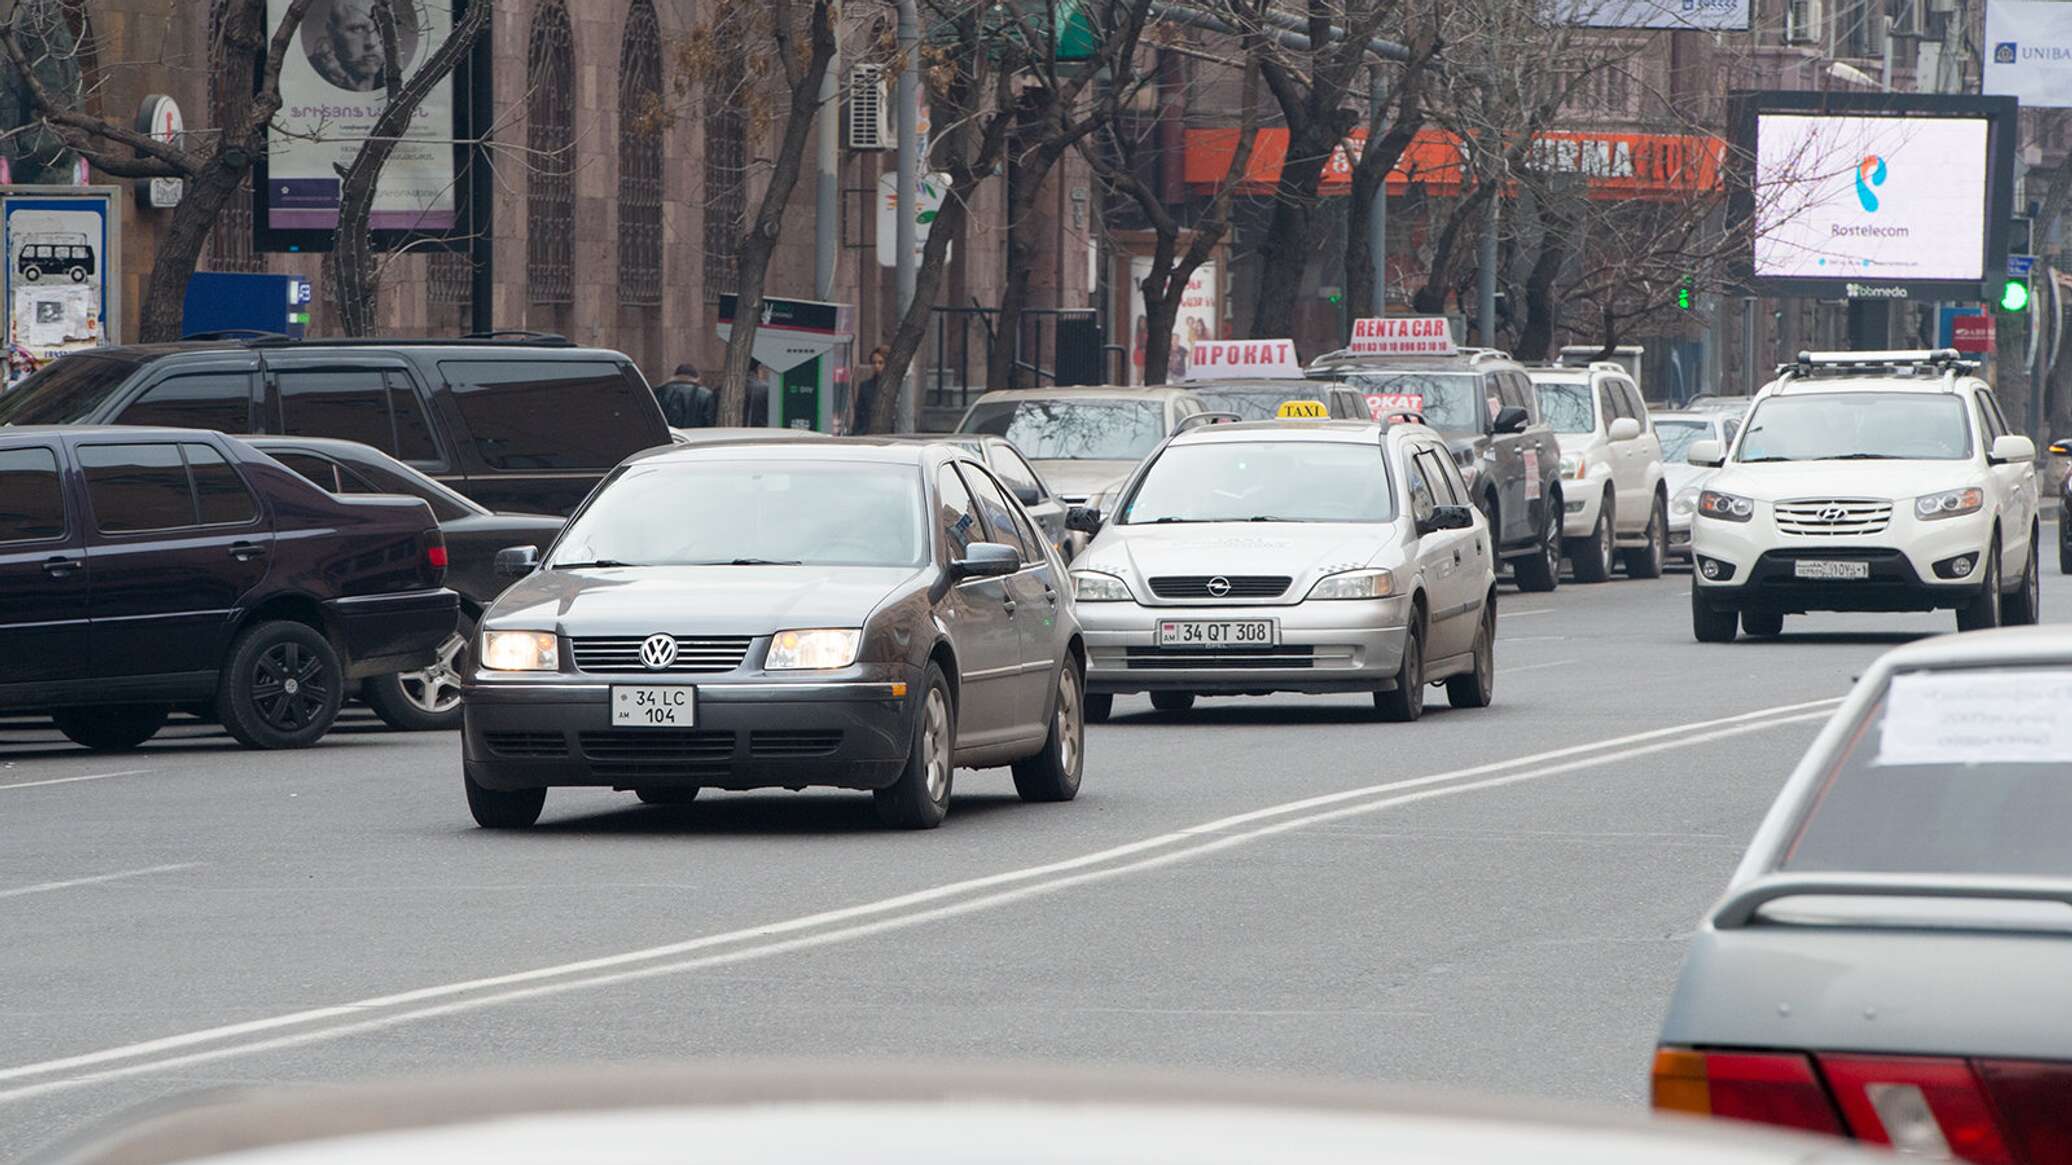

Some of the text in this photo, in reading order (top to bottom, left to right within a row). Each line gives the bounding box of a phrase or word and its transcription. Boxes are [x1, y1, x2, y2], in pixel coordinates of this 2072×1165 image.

[2022, 47, 2072, 60] UNIBA
[1831, 224, 1910, 237] Rostelecom
[1355, 320, 1444, 337] RENT A CAR
[1194, 344, 1289, 366] ПРОКАТ
[1366, 396, 1422, 410] ОКАТ
[1284, 405, 1320, 417] TAXI
[1163, 623, 1266, 642] AM 34 QT 308
[636, 691, 685, 706] 34 LC
[645, 708, 675, 723] 104
